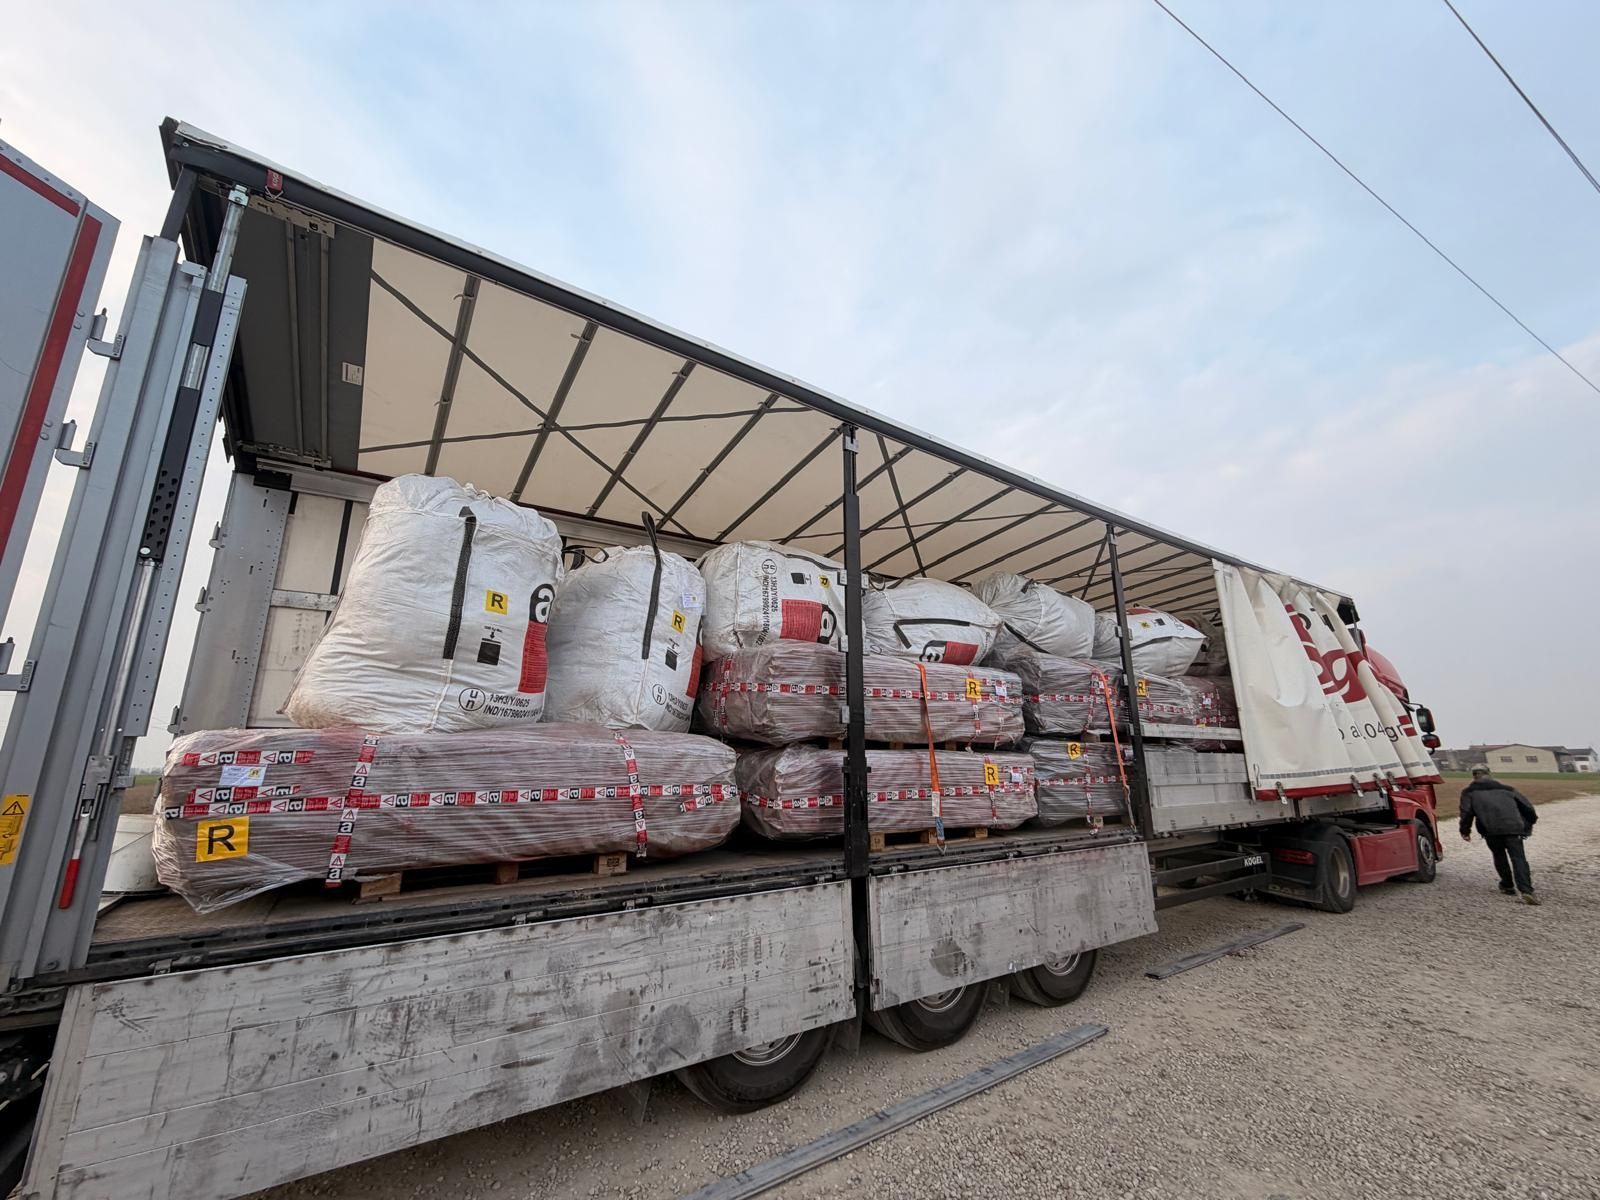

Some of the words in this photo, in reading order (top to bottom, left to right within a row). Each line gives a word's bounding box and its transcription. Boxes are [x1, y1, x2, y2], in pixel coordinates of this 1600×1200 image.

[491, 593, 504, 610] R
[536, 587, 554, 623] a
[673, 614, 682, 629] R
[969, 681, 978, 696] R
[1137, 681, 1145, 695] R
[1070, 743, 1078, 754] R
[987, 766, 996, 781] R
[353, 776, 365, 787] a
[341, 822, 353, 833] a
[207, 824, 236, 855] R
[330, 868, 341, 879] a
